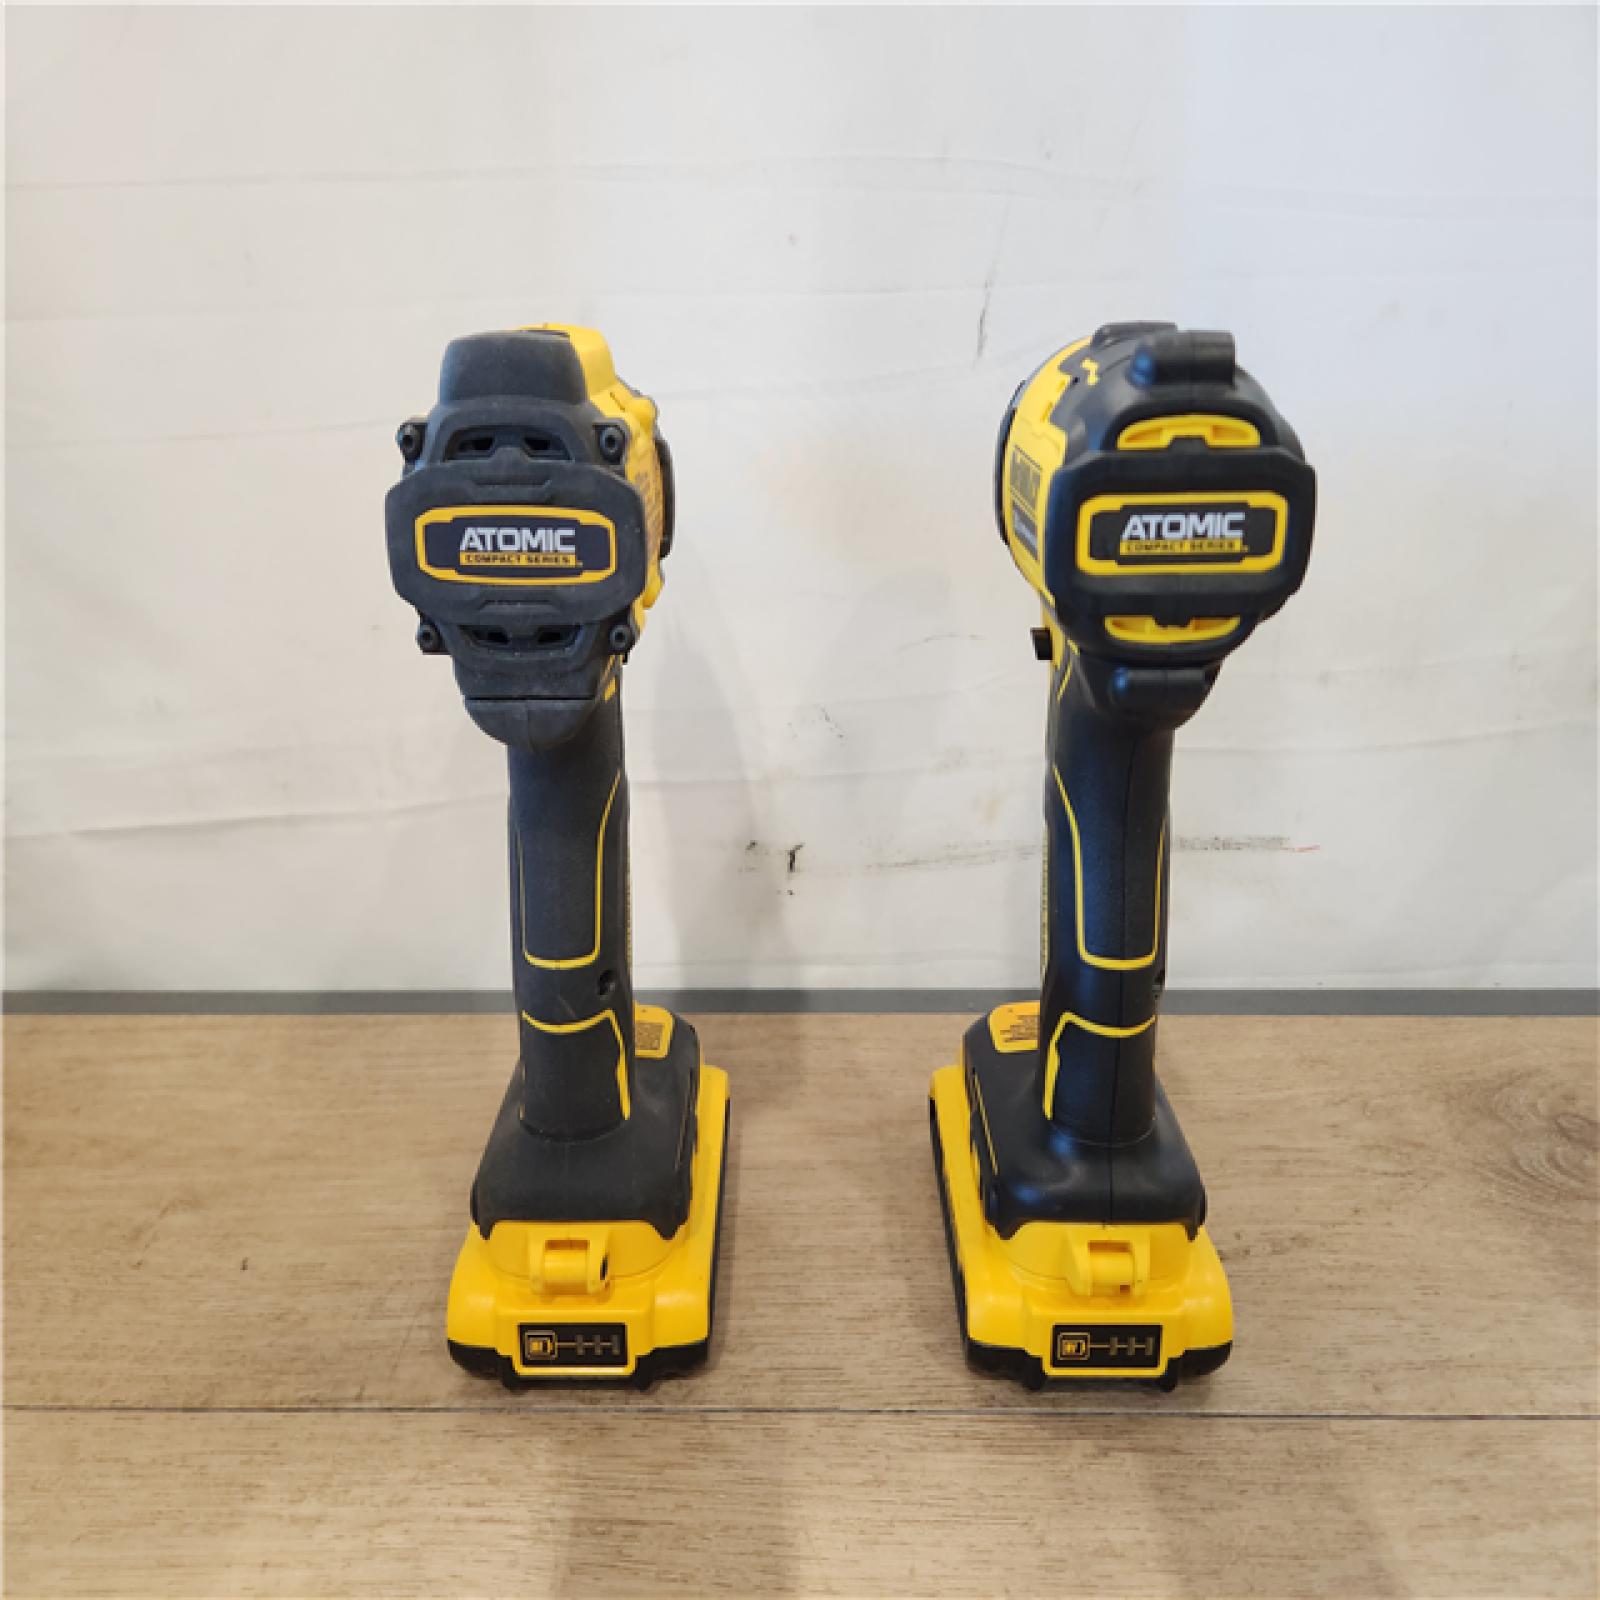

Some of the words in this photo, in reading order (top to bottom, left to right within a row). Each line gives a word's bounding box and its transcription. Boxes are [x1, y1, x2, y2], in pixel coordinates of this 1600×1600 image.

[1121, 512, 1246, 540] ATOMIC
[460, 526, 576, 552] ATOMIC
[1126, 541, 1184, 551] COMPACT
[1190, 540, 1235, 550] SERIES
[464, 554, 521, 564] COMPACT
[526, 554, 571, 564] SERIES
